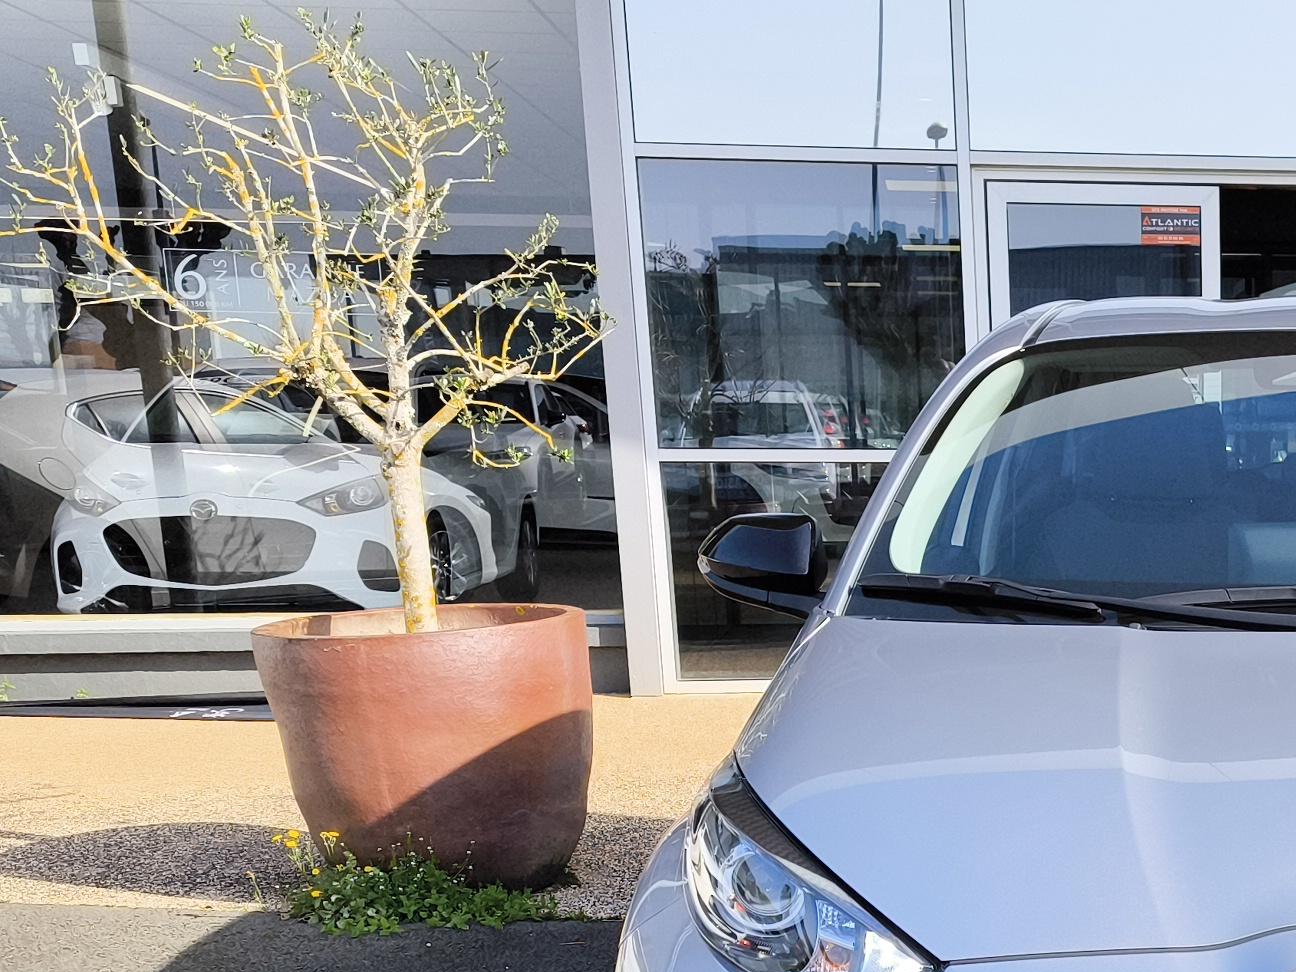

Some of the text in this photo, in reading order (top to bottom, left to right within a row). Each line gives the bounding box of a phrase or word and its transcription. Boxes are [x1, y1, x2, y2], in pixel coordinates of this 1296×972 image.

[1142, 215, 1199, 227] ATLANTIC
[174, 253, 231, 300] 6 ANS
